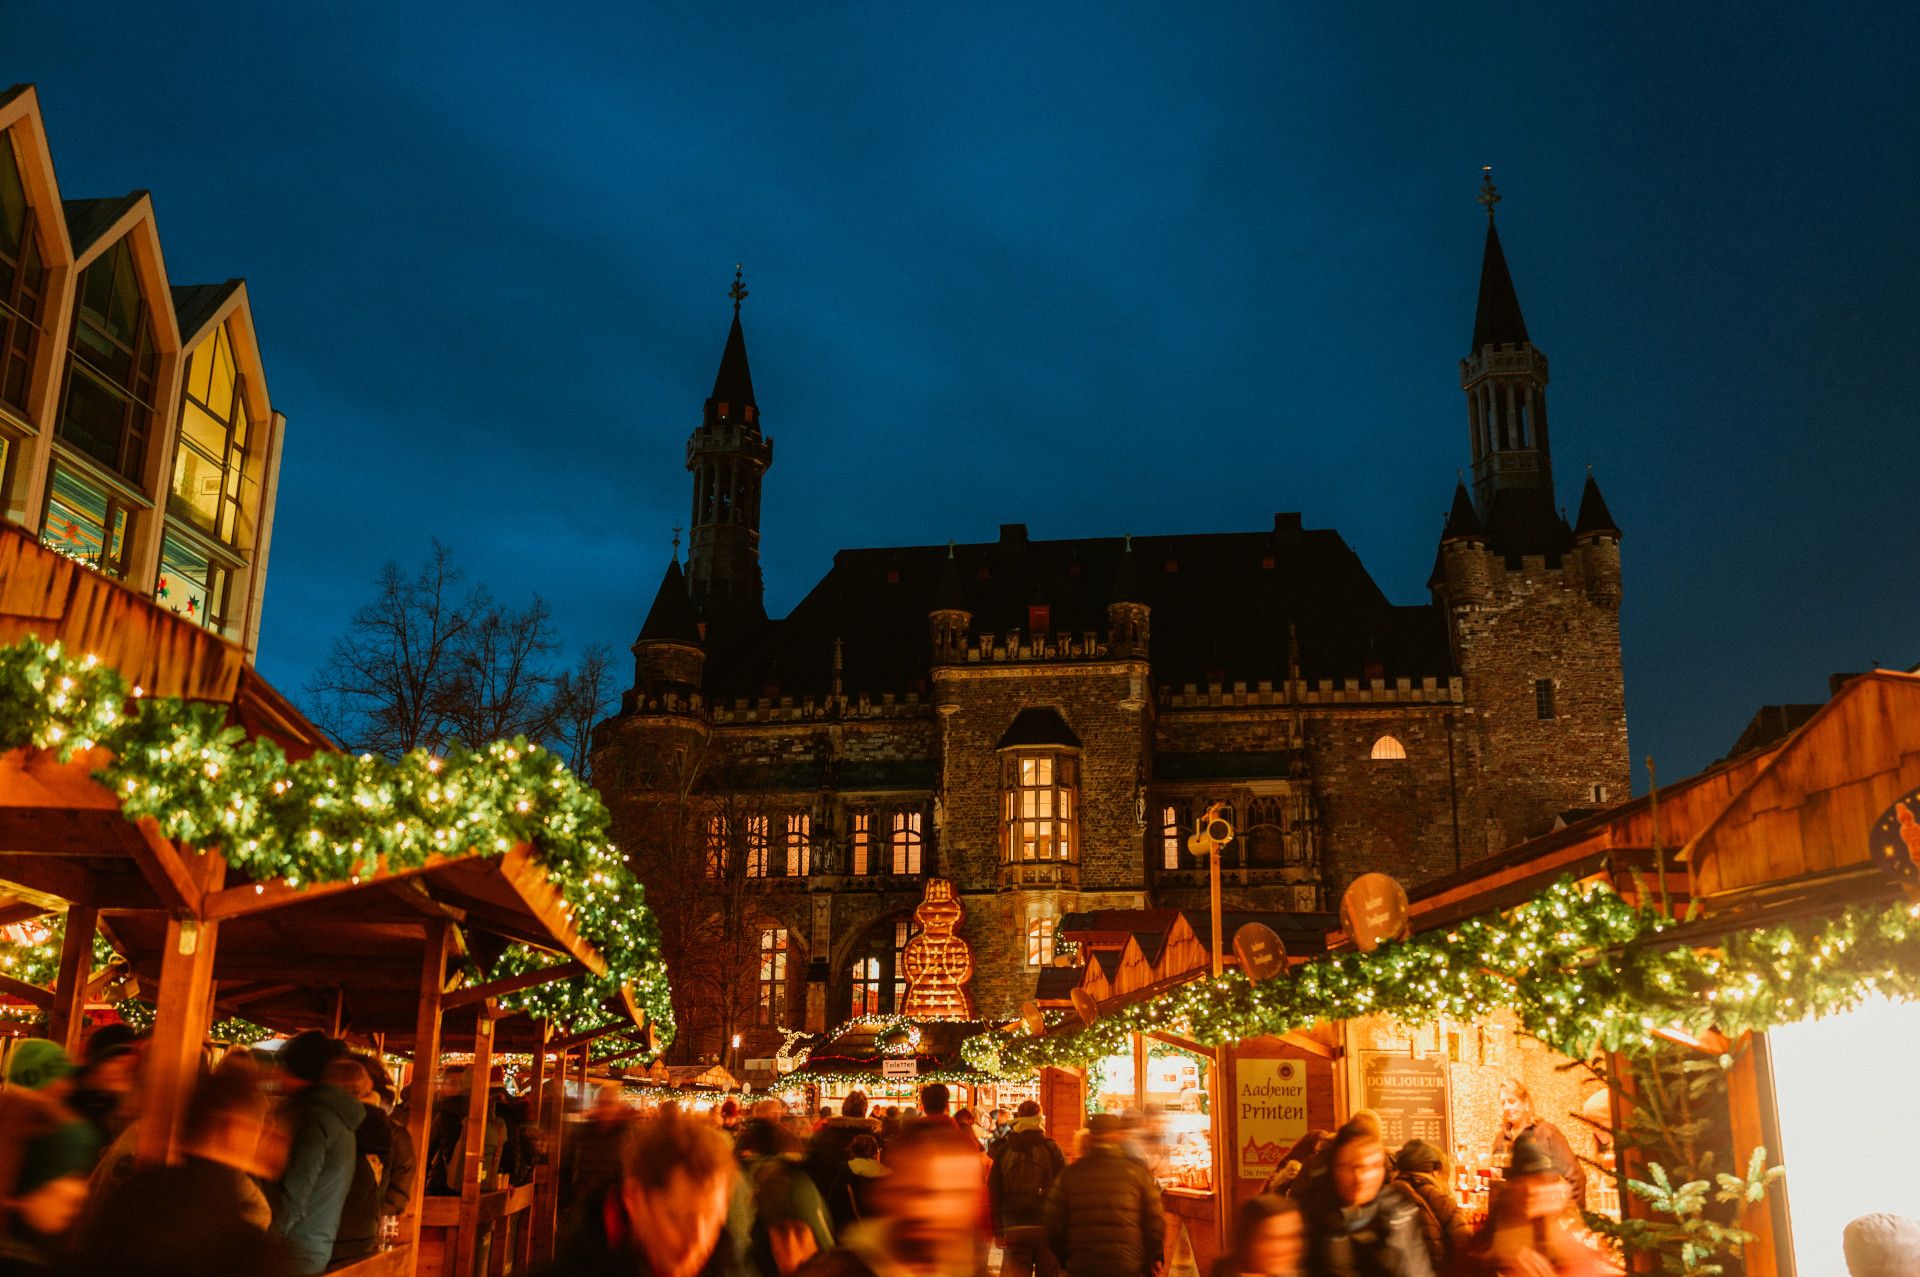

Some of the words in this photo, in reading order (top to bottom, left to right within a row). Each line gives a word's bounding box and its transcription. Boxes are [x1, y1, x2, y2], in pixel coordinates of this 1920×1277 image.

[1242, 1077, 1303, 1099] Aachener
[1367, 1076, 1444, 1088] DOMLIQUEUR
[1242, 1101, 1304, 1120] Printen
